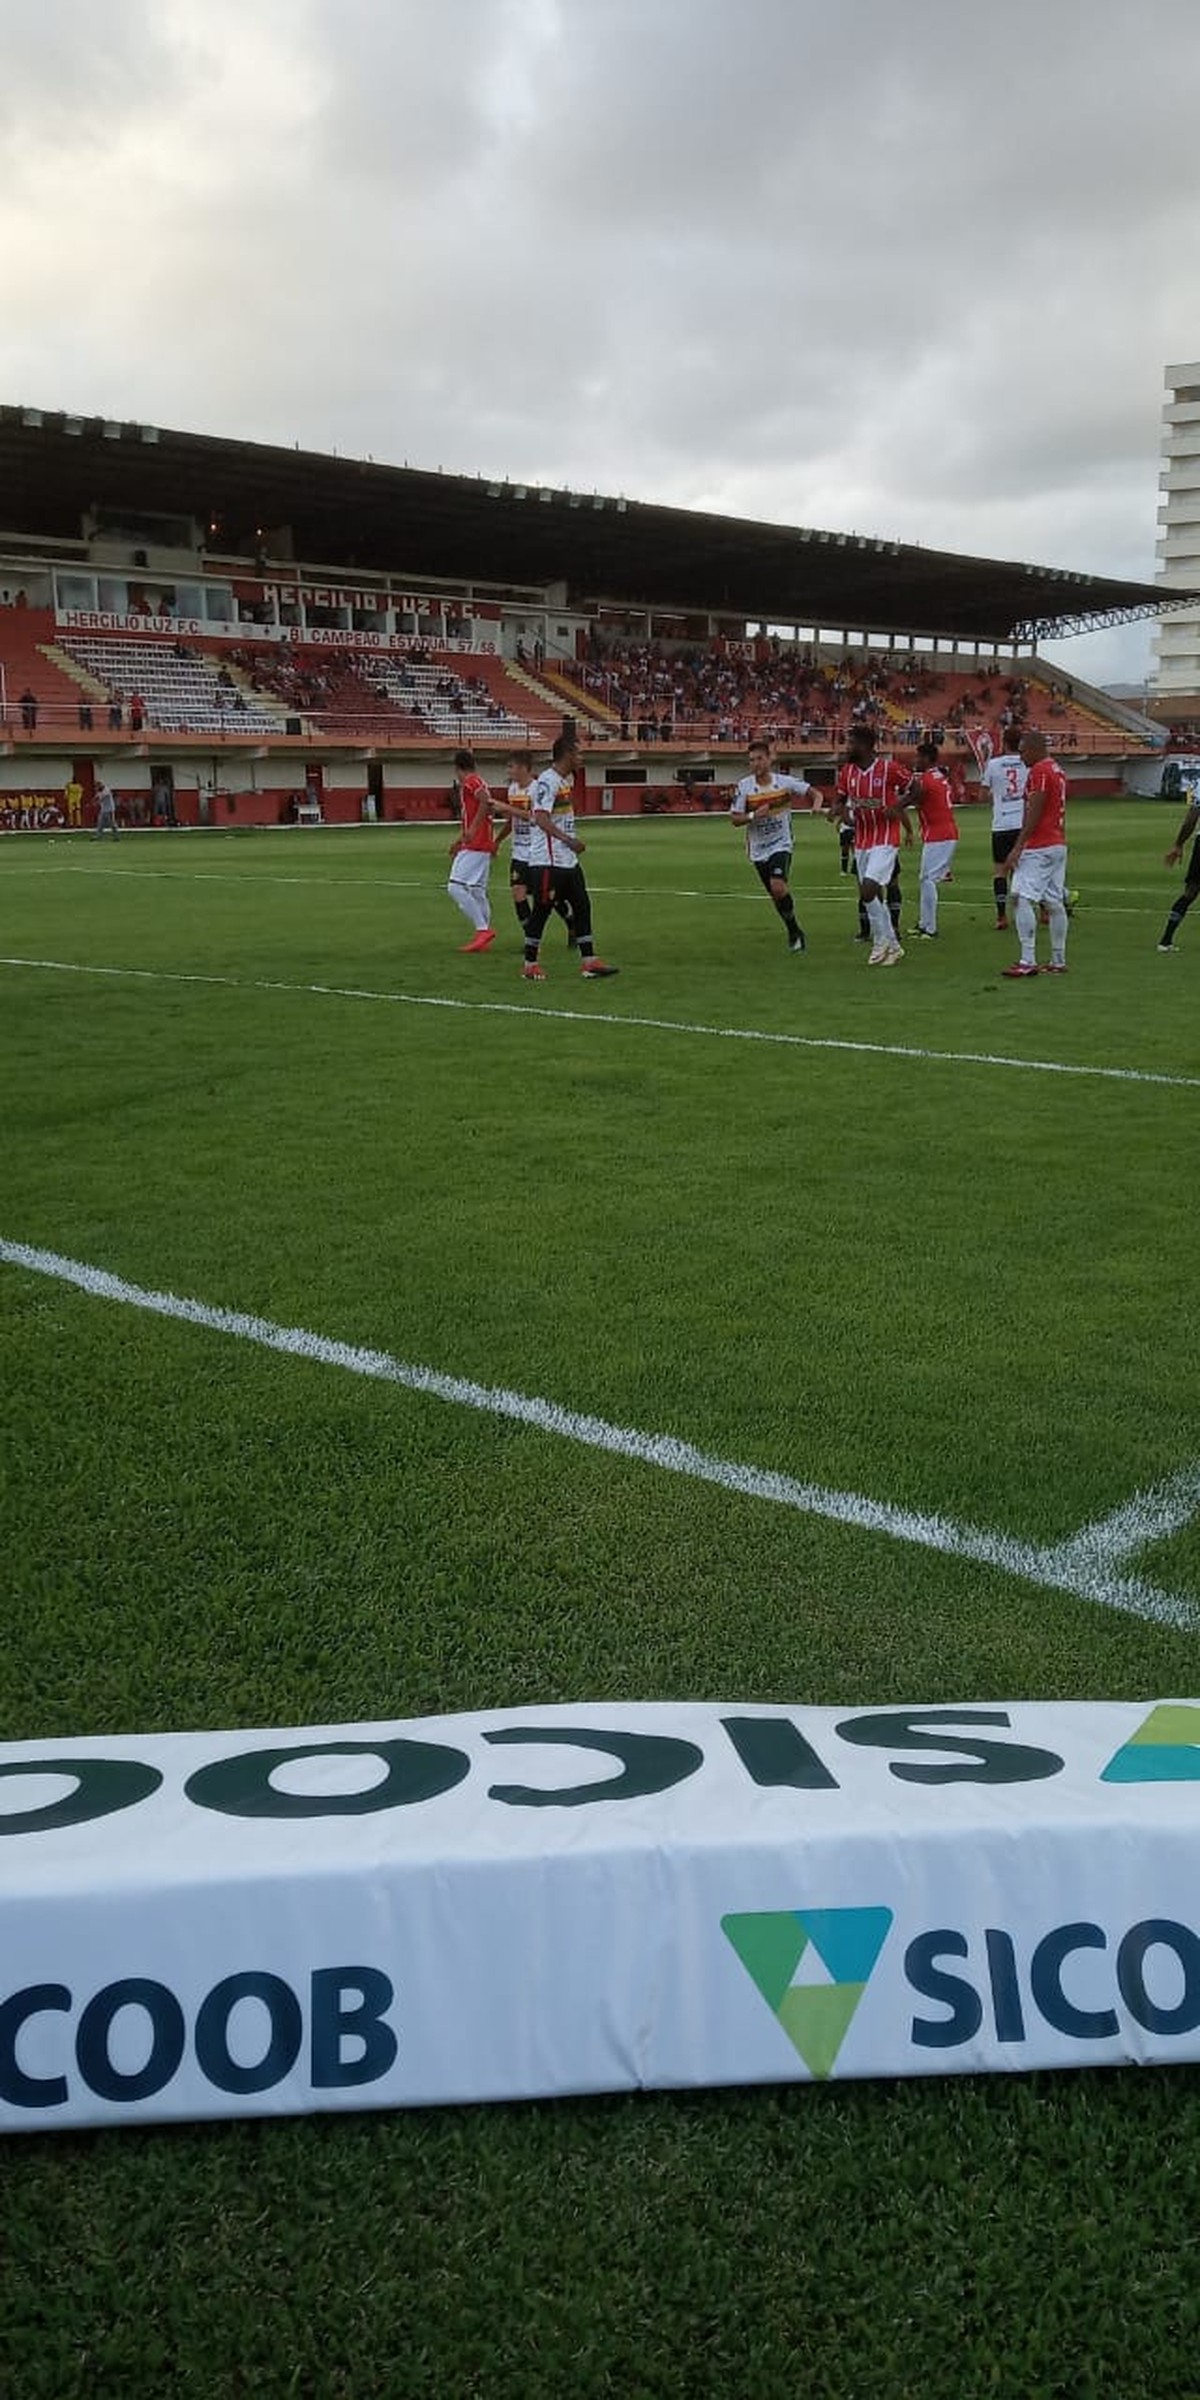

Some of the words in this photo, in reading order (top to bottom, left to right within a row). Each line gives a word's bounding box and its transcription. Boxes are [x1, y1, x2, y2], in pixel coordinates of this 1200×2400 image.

[263, 584, 378, 611] HERCILIO
[388, 596, 431, 616] LUZ
[66, 611, 140, 631] HERCILIO
[144, 617, 173, 633] LUZ
[389, 635, 451, 651] ESTADUAL
[1005, 768, 1018, 797] 3
